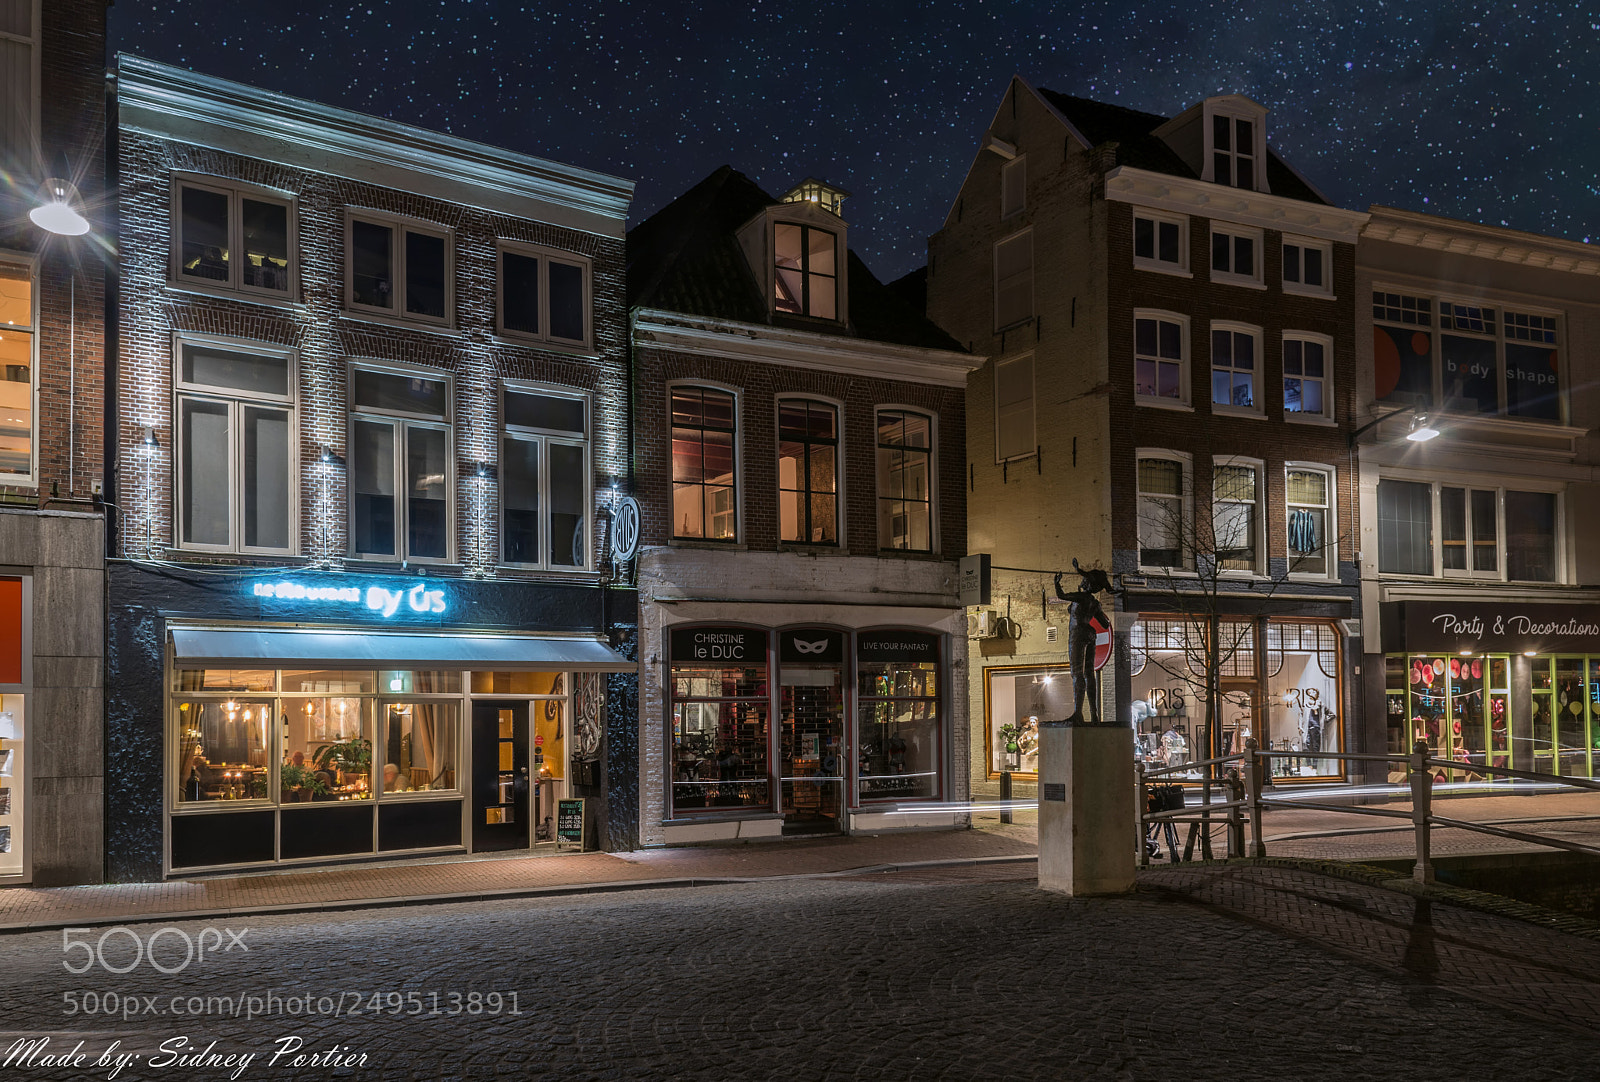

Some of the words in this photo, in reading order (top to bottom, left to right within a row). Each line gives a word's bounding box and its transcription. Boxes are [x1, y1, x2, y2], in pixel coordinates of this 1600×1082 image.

[1447, 359, 1489, 379] body
[1506, 367, 1556, 385] shape
[1431, 613, 1485, 640] Party
[1493, 615, 1506, 635] &
[1507, 615, 1600, 636] Decorations
[694, 633, 745, 645] CHRISTINE
[863, 642, 878, 651] LIVE
[879, 642, 899, 651] YOUR
[900, 643, 929, 652] FANTASY
[694, 645, 707, 659] le
[711, 645, 745, 659] DUC
[1150, 687, 1185, 710] IRIS
